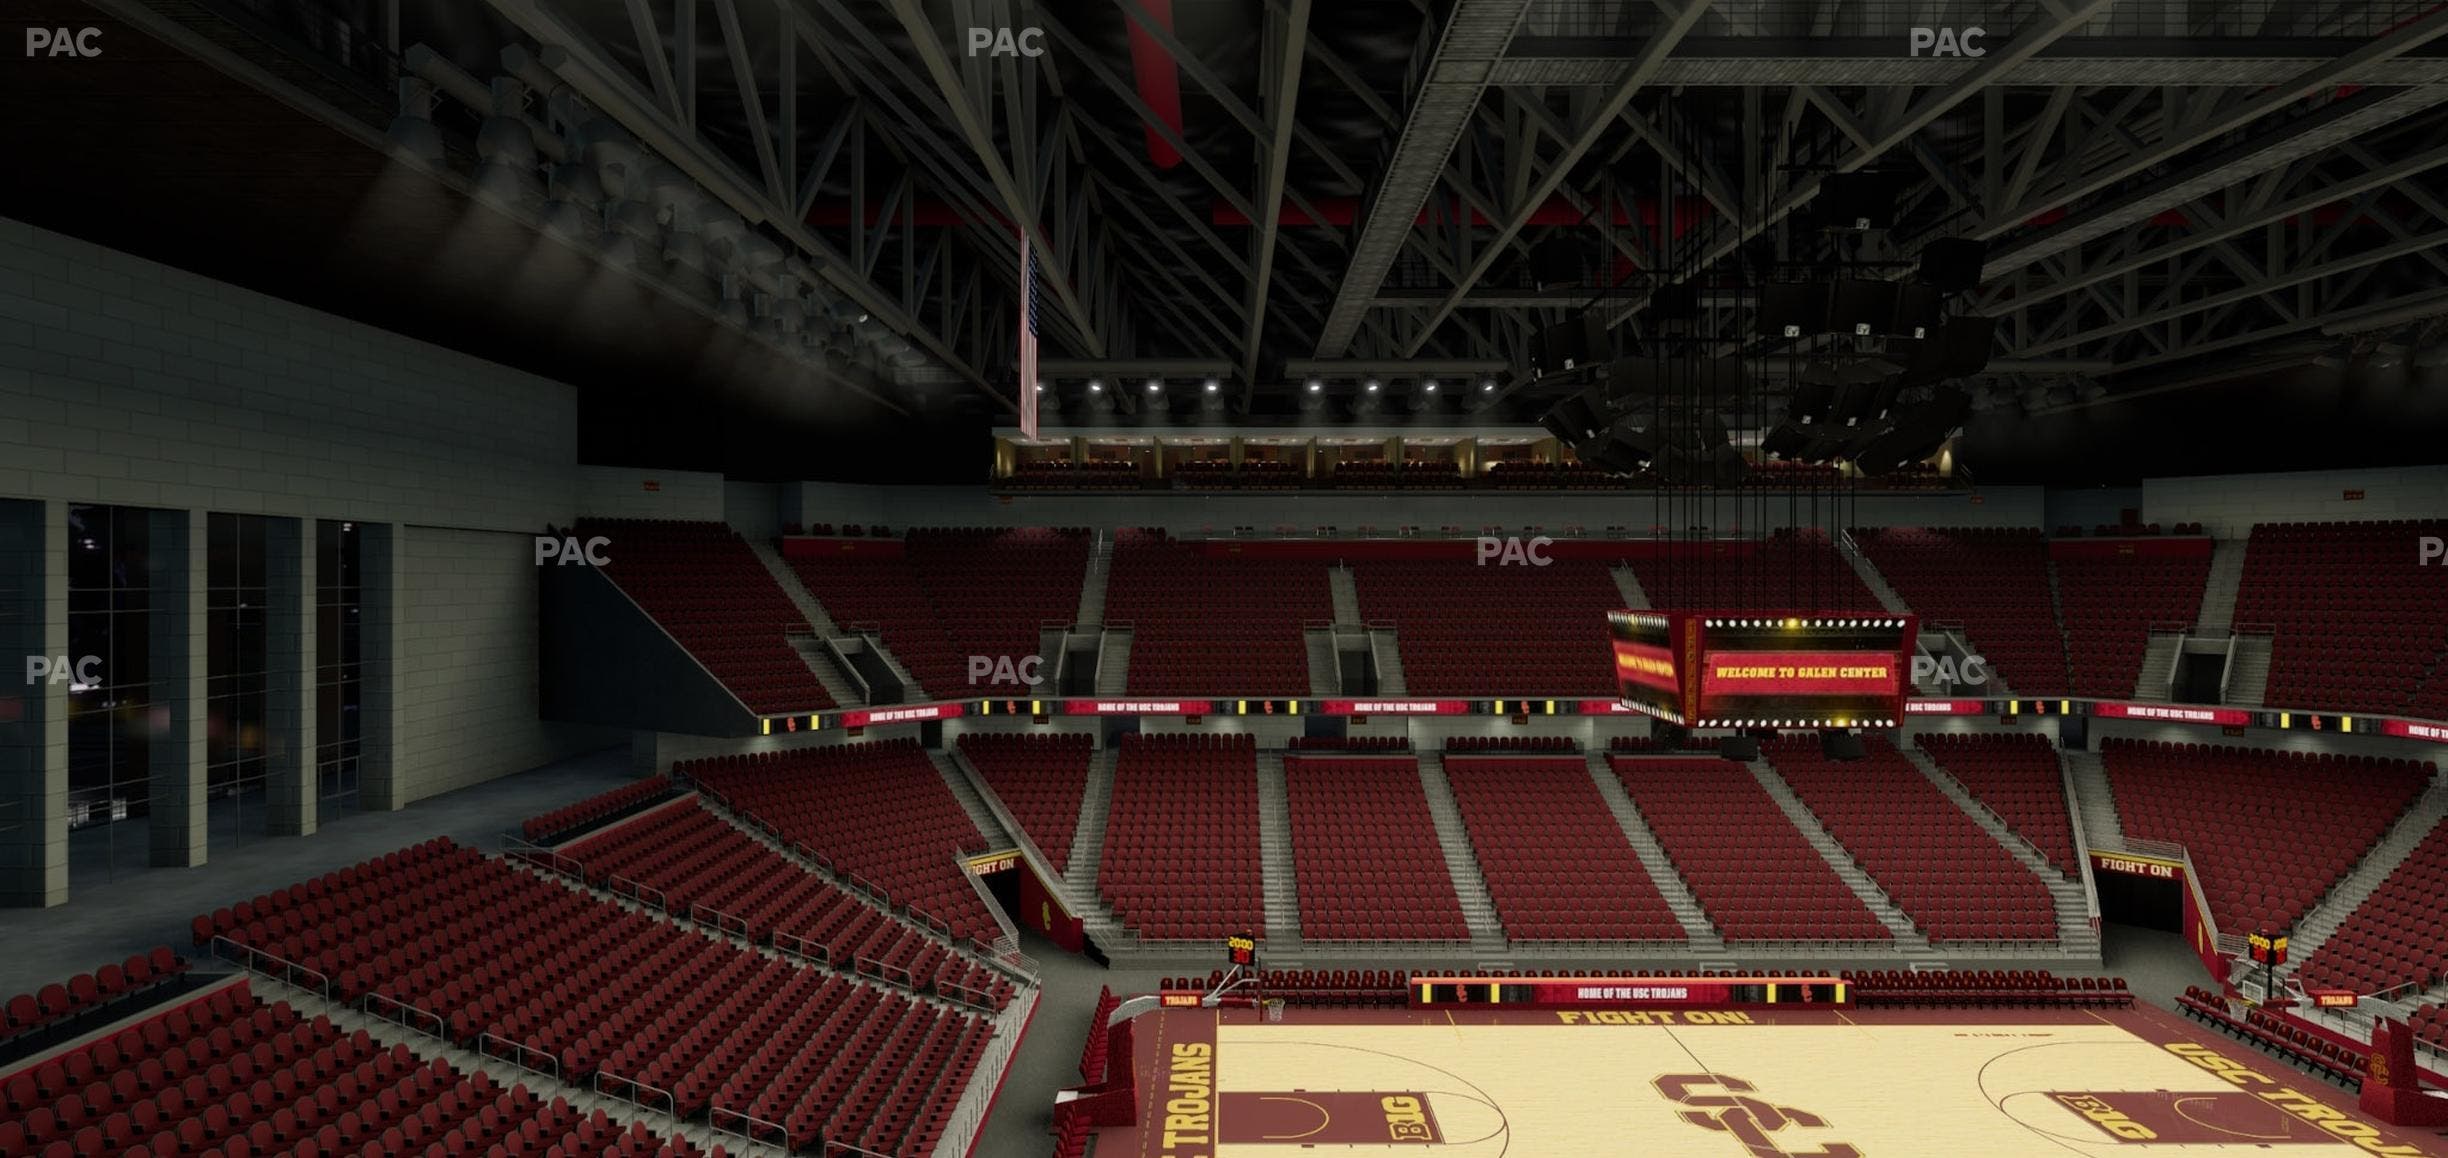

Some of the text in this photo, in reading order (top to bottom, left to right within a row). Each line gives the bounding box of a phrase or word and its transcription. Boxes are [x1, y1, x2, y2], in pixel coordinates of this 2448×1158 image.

[1716, 666, 1888, 678] WELCOME TO GALEN CENTER
[1116, 703, 1125, 711] OF
[1126, 703, 1137, 711] THE
[1373, 703, 1382, 711] OF
[1383, 703, 1394, 711] THE
[2147, 708, 2155, 717] OF
[2156, 708, 2168, 718] THE
[2408, 725, 2428, 737] HOME
[2430, 728, 2439, 738] OF
[973, 858, 1014, 876] IGHT ON
[2101, 858, 2172, 877] FIGHT ON
[1578, 988, 1687, 998] HOME OF THE USC TROJANS
[1556, 1011, 1755, 1024] FIGHT ON!
[1162, 1042, 1212, 1149] TROJANS
[2164, 1043, 2440, 1158] USC TROJ
